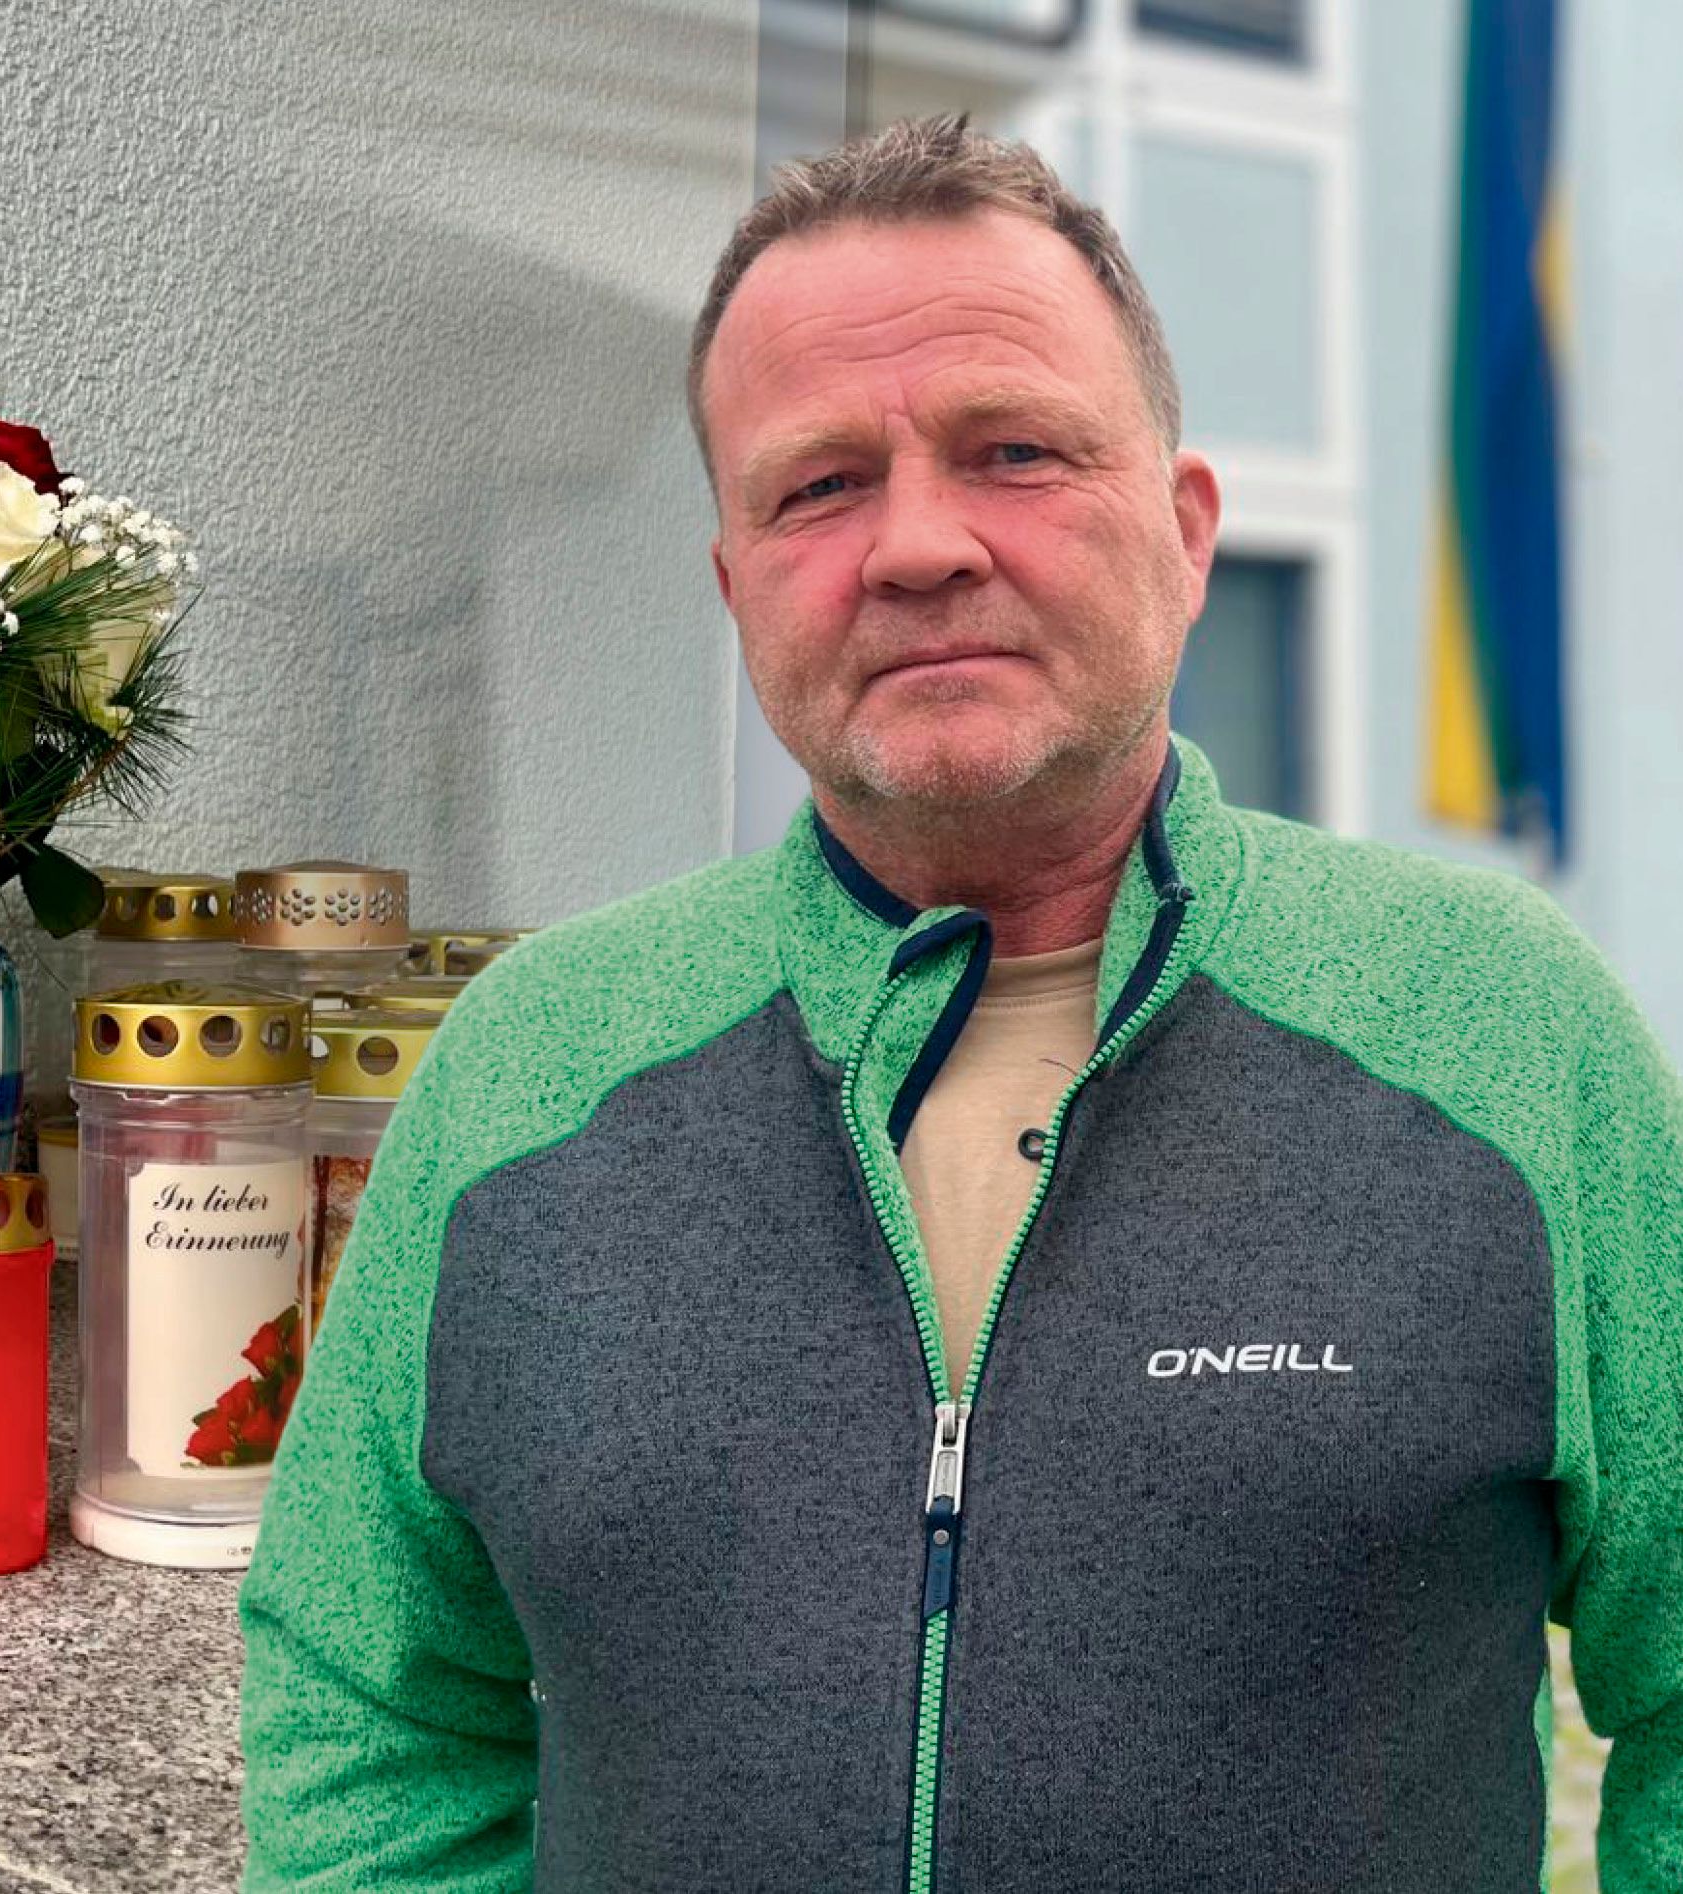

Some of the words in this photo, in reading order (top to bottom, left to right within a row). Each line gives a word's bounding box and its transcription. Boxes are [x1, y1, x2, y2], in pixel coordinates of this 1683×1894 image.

[153, 1182, 195, 1211] In
[202, 1183, 270, 1211] lieber
[144, 1220, 291, 1260] Erinnerung
